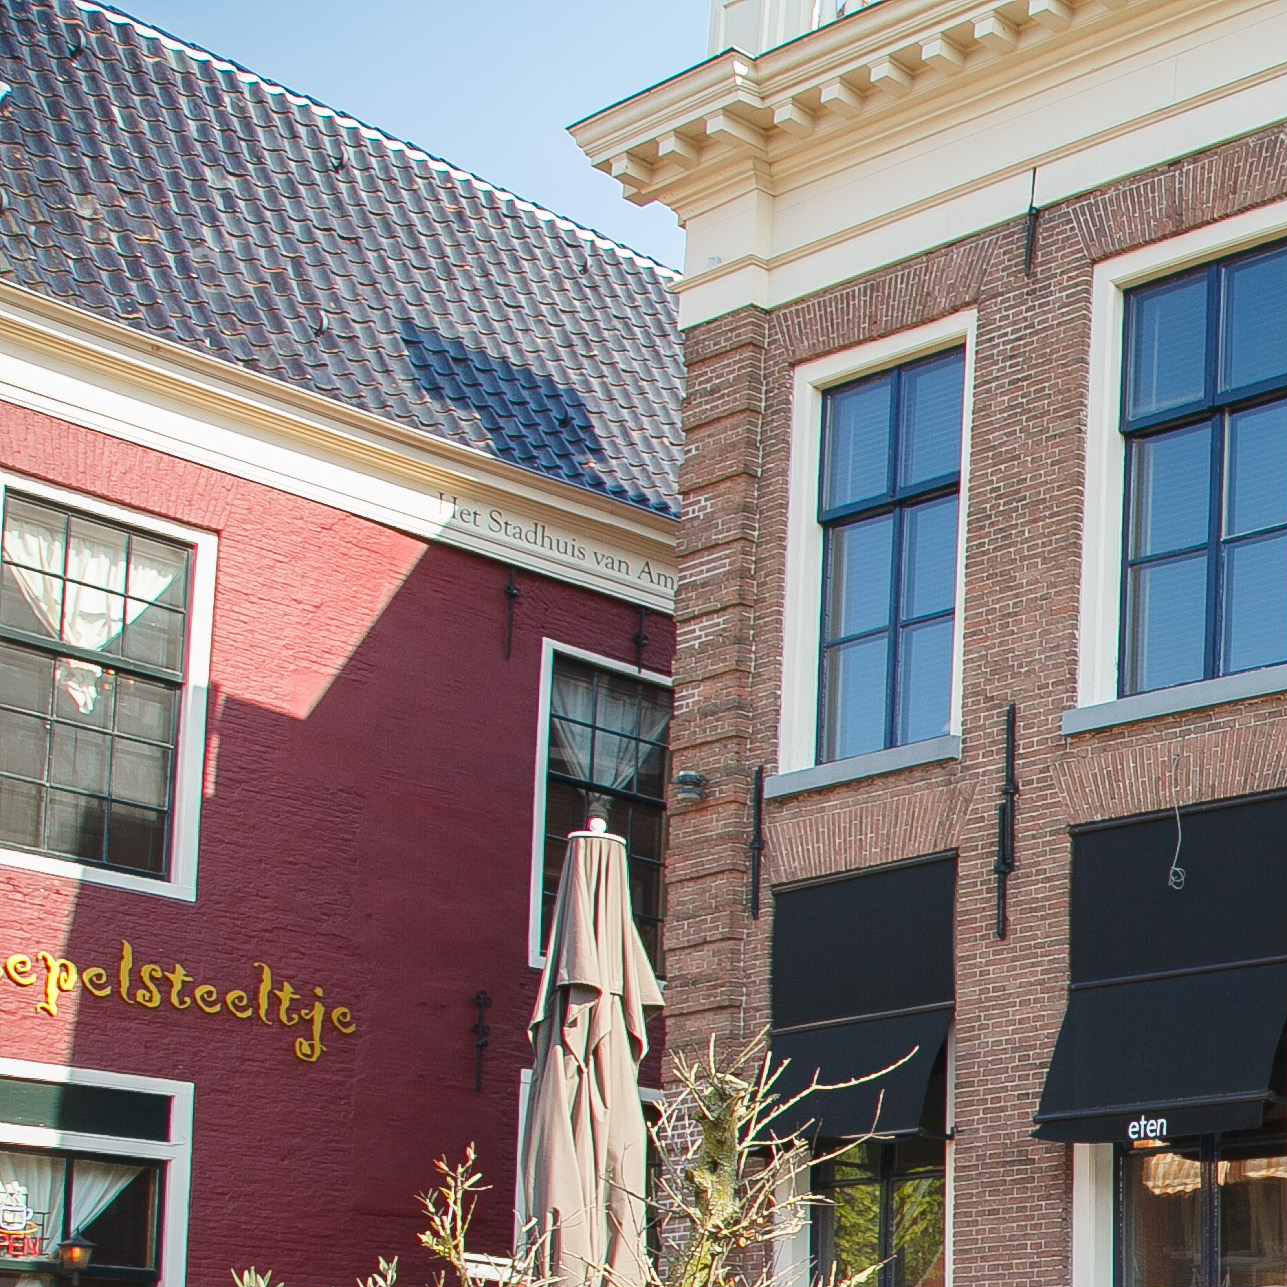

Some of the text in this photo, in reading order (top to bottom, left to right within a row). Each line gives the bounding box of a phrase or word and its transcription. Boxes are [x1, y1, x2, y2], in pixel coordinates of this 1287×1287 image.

[488, 509, 586, 561] Stadhuis
[592, 550, 631, 575] van
[0, 940, 356, 1062] epelsteeltje
[1128, 1115, 1167, 1139] eten
